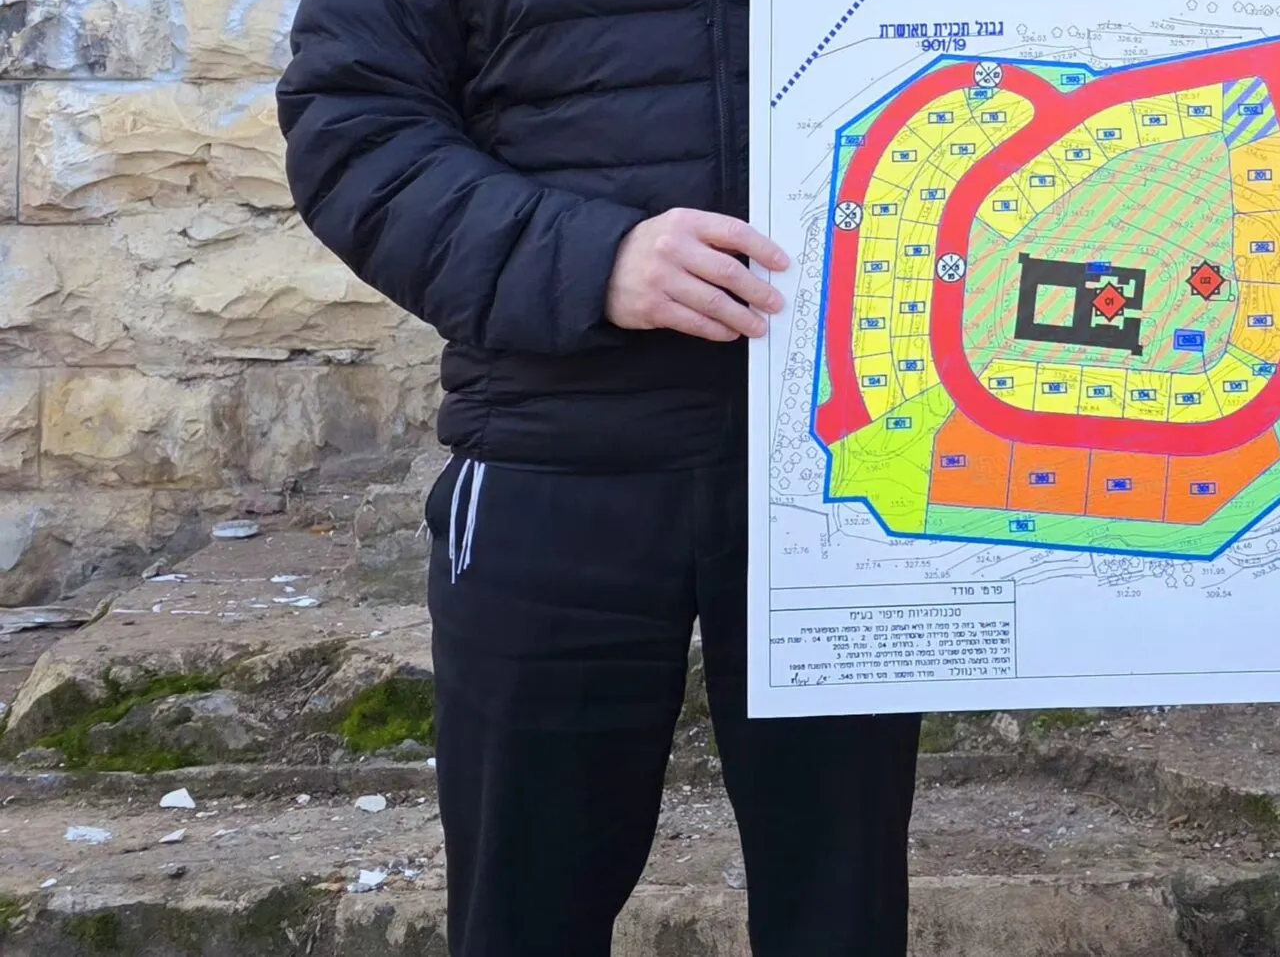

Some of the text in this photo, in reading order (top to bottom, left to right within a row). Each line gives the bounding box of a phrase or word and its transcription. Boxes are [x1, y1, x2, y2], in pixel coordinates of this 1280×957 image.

[879, 20, 1004, 39] גבול תכנית מאושרת
[921, 38, 967, 53] 901/19
[951, 586, 1003, 596] פרטי מודד
[878, 609, 904, 620] מיפוי
[908, 607, 961, 619] טכנולוגיות
[948, 667, 988, 677] גרינוולד
[992, 666, 1011, 675] יאיר
